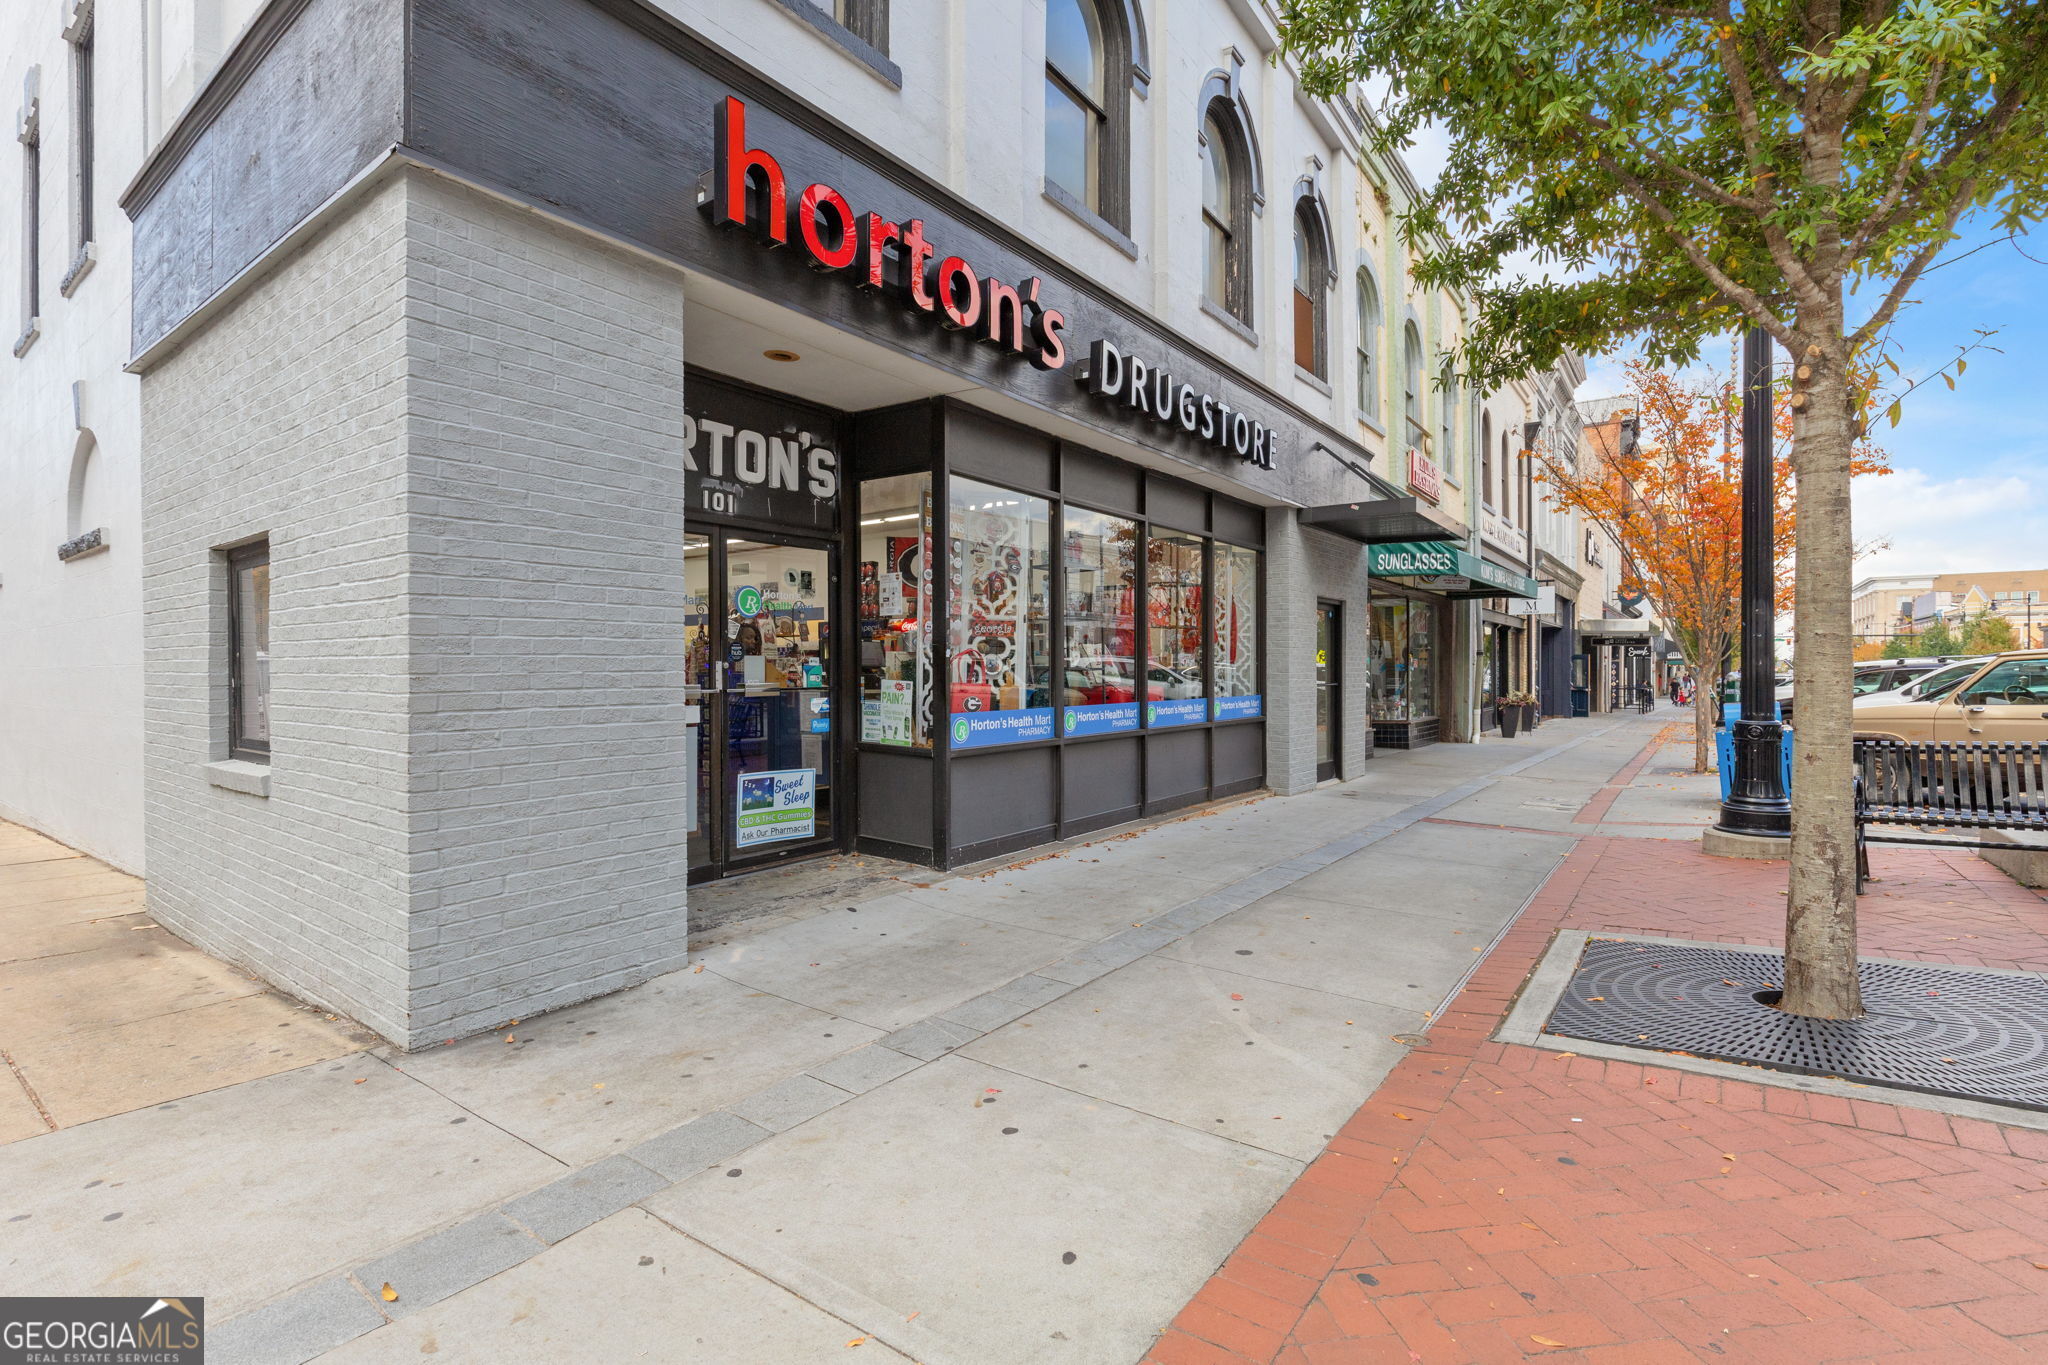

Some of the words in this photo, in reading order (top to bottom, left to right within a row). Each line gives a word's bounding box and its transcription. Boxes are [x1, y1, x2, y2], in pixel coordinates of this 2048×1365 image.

[714, 95, 1065, 371] horton's
[1090, 339, 1278, 470] DRUGSTORE
[703, 490, 735, 514] 101
[1377, 552, 1451, 571] SUNGLASSES
[974, 623, 1013, 635] georgia
[1077, 711, 1105, 722] Horton's
[1105, 709, 1124, 720] Health
[1124, 708, 1137, 719] Mart
[1156, 706, 1178, 715] Horton's
[1178, 704, 1194, 713] Health
[971, 717, 1007, 731] Horton's
[1008, 715, 1033, 728] Health
[1035, 714, 1051, 726] Mart
[1112, 718, 1137, 728] PHARMACY
[1018, 725, 1051, 737] PHARMACY
[775, 774, 804, 794] Sweet
[784, 790, 810, 806] Sleep
[740, 816, 754, 826] CBD
[762, 814, 777, 822] THC
[777, 810, 811, 821] Gummies
[742, 831, 756, 841] Ask
[756, 829, 769, 838] Our
[770, 824, 810, 836] Pharmacist
